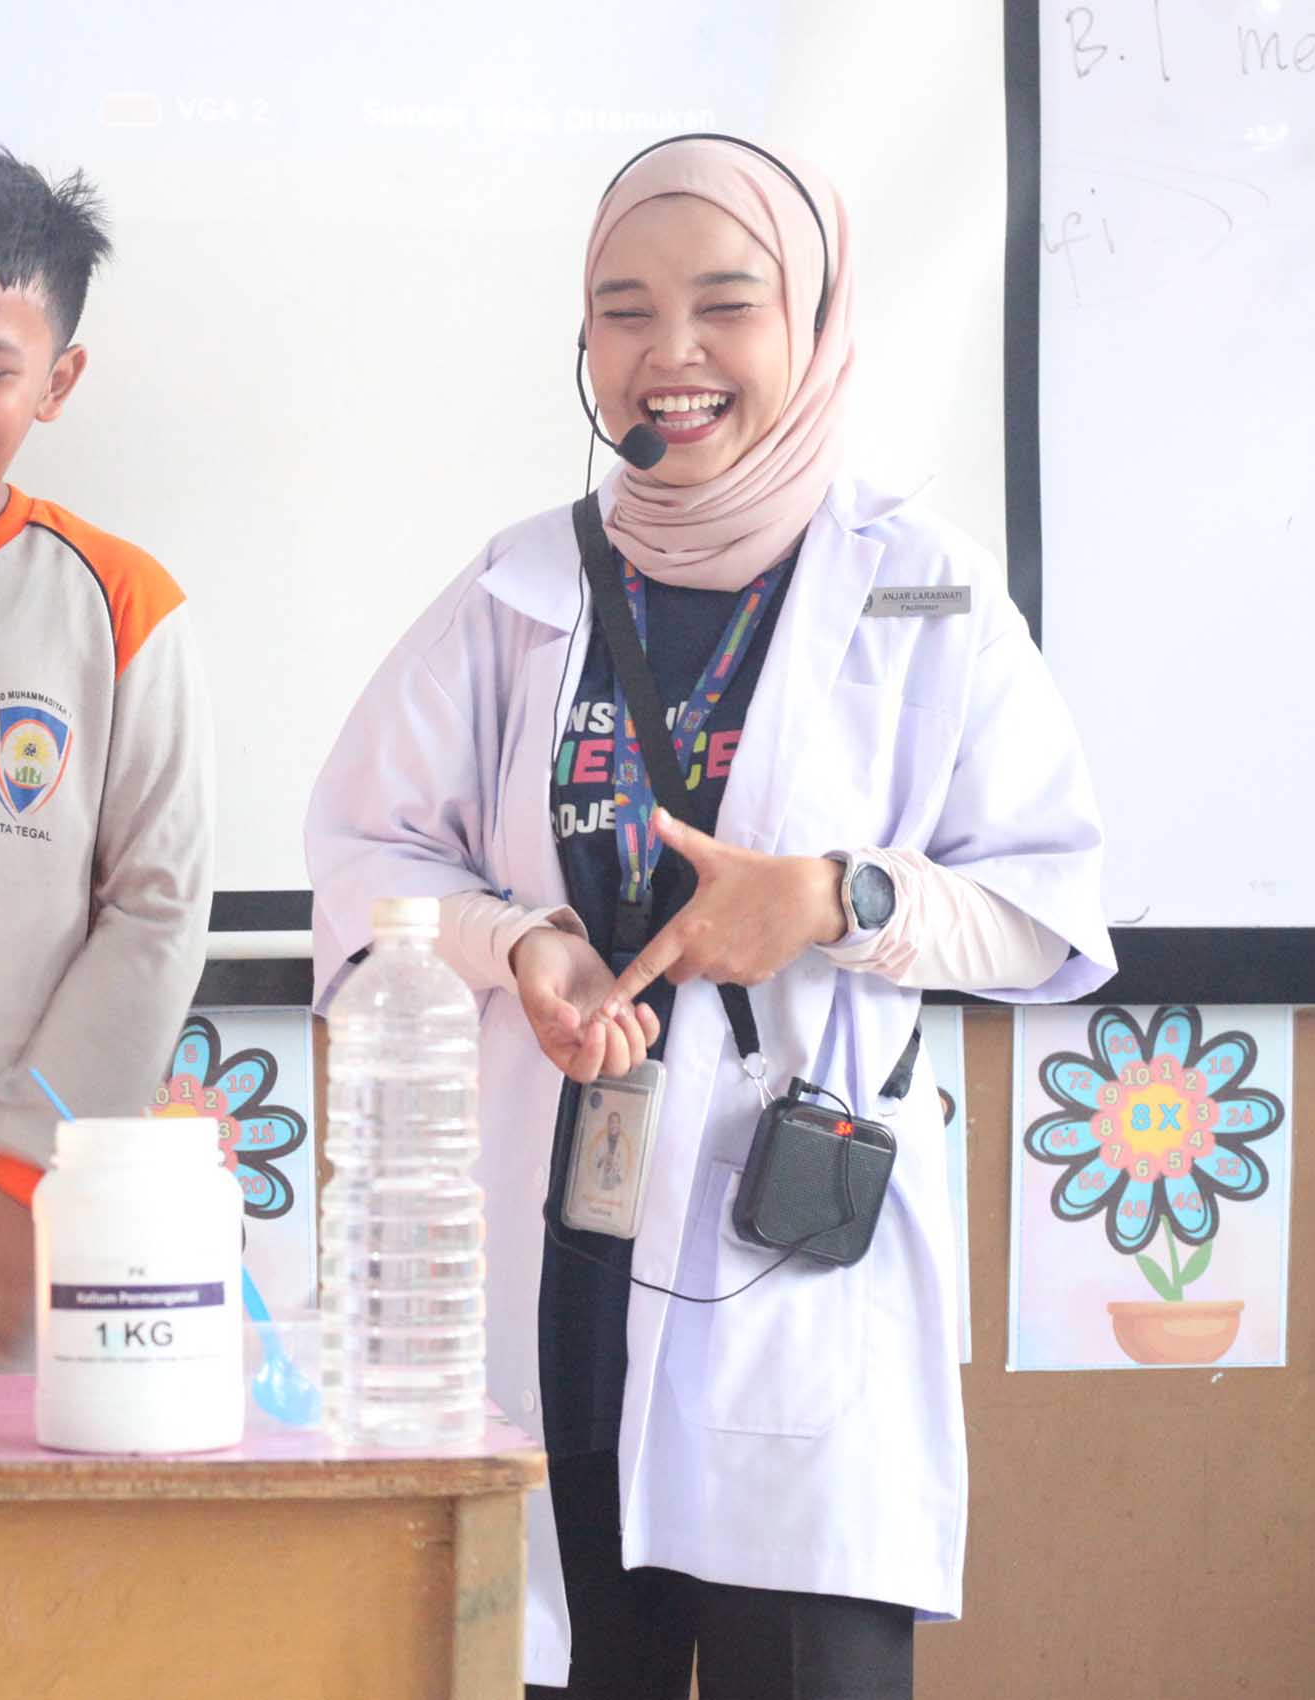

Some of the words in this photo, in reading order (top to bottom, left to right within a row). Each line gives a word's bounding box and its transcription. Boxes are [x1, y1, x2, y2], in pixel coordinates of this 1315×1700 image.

[16, 825, 52, 842] TEGAL
[1166, 1027, 1179, 1044] 8
[185, 1045, 198, 1063] 5
[1108, 1037, 1135, 1054] 80
[1162, 1063, 1173, 1080] 1
[1207, 1057, 1233, 1075] 16
[228, 1074, 255, 1093] 10
[1068, 1072, 1093, 1090] 72
[1124, 1068, 1151, 1085] 10
[1185, 1074, 1197, 1090] 2
[155, 1087, 170, 1104] 0
[180, 1082, 193, 1099] 1
[1105, 1087, 1119, 1104] 9
[204, 1091, 217, 1109] 2
[1197, 1104, 1210, 1121] 3
[1226, 1108, 1253, 1126] 24
[250, 1125, 276, 1144] 15
[1100, 1119, 1113, 1136] 8
[1050, 1129, 1078, 1147] 64
[1189, 1131, 1203, 1148] 4
[1111, 1145, 1123, 1162] 7
[1169, 1152, 1182, 1169] 5
[1136, 1160, 1149, 1177] 6
[1216, 1158, 1242, 1176] 32
[239, 1176, 266, 1194] 20
[1078, 1172, 1105, 1190] 56
[1119, 1200, 1148, 1218] 48
[1173, 1193, 1201, 1211] 40
[96, 1321, 108, 1347] 1
[124, 1321, 174, 1347] KG
